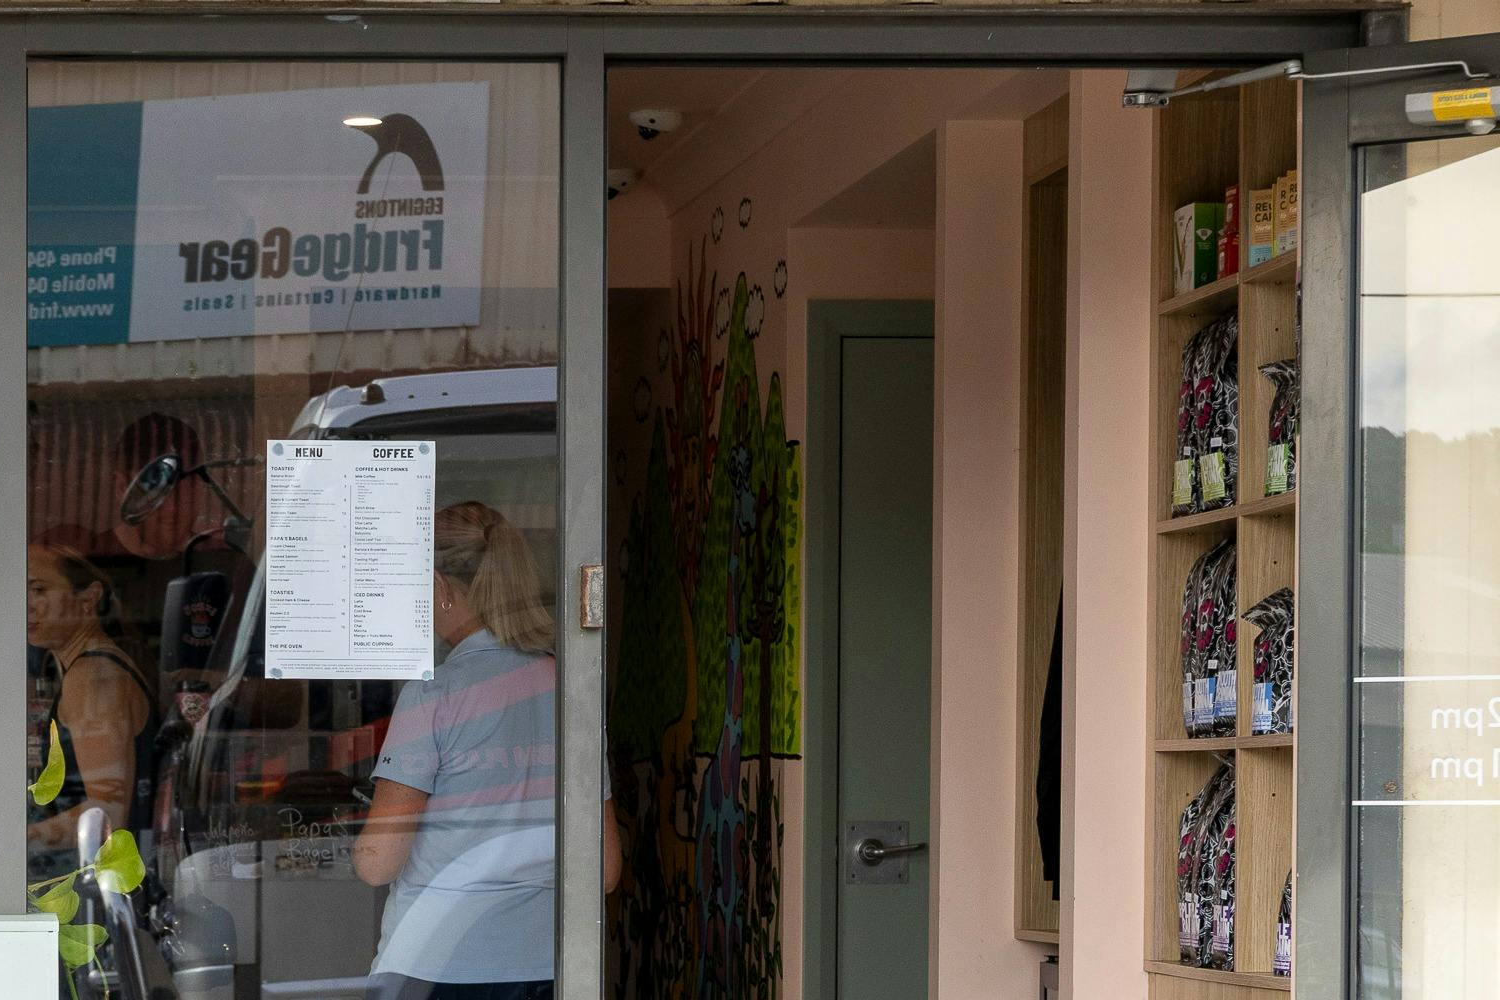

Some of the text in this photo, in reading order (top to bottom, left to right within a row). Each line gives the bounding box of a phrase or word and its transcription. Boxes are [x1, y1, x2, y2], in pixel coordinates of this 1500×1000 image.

[295, 448, 323, 457] MENU
[373, 448, 414, 458] COFFEE
[278, 808, 350, 846] Papa's
